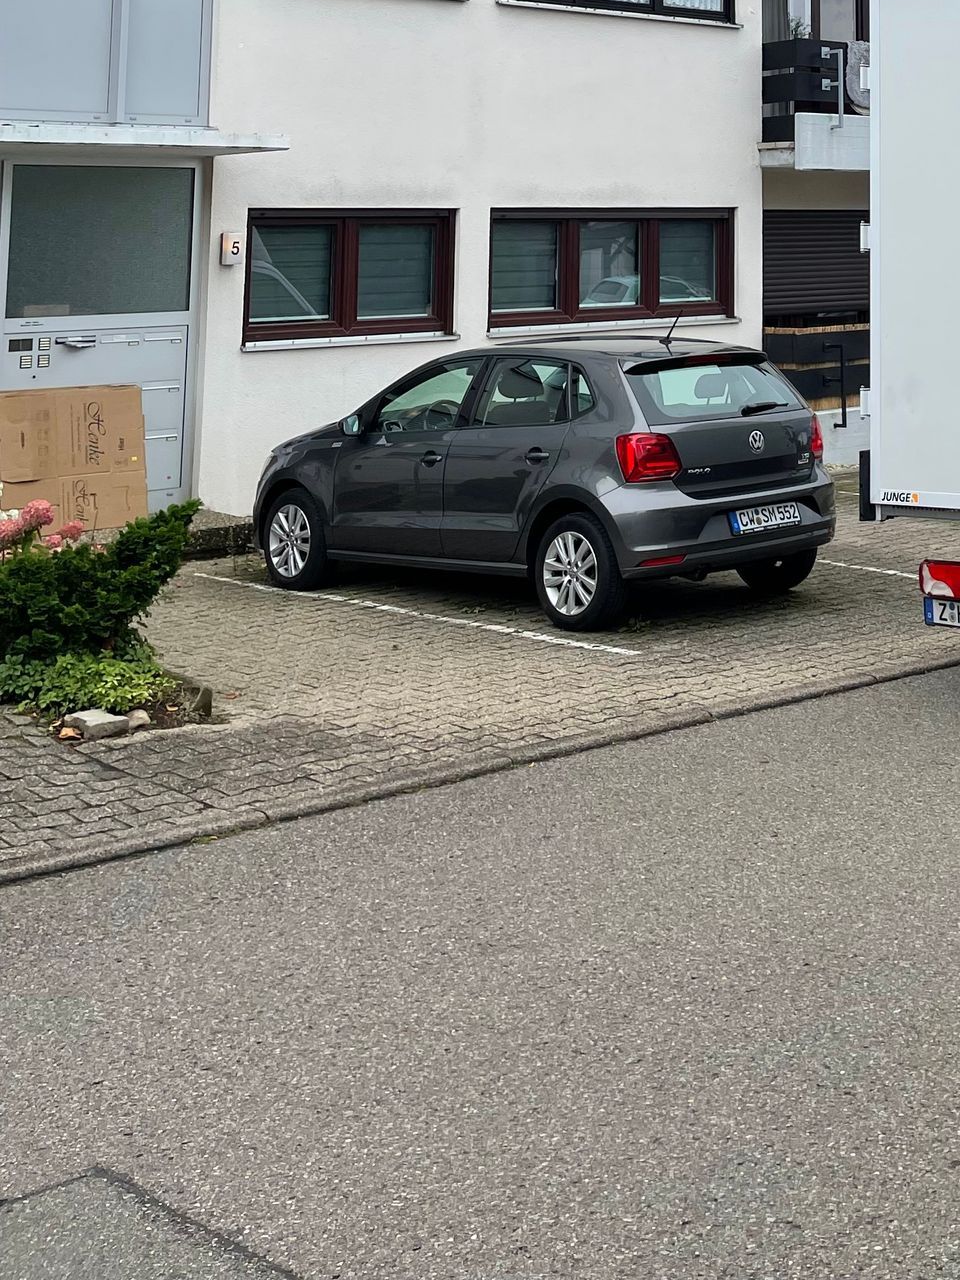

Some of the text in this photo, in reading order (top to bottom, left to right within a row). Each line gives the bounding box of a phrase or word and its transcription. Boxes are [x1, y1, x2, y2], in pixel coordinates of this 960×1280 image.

[231, 241, 240, 256] 5
[87, 401, 107, 466] Henke
[75, 479, 90, 523] Hen
[882, 491, 911, 503] JUNGE
[739, 510, 756, 527] CW
[760, 506, 778, 523] SM
[777, 504, 799, 521] 552
[938, 602, 948, 622] Z
